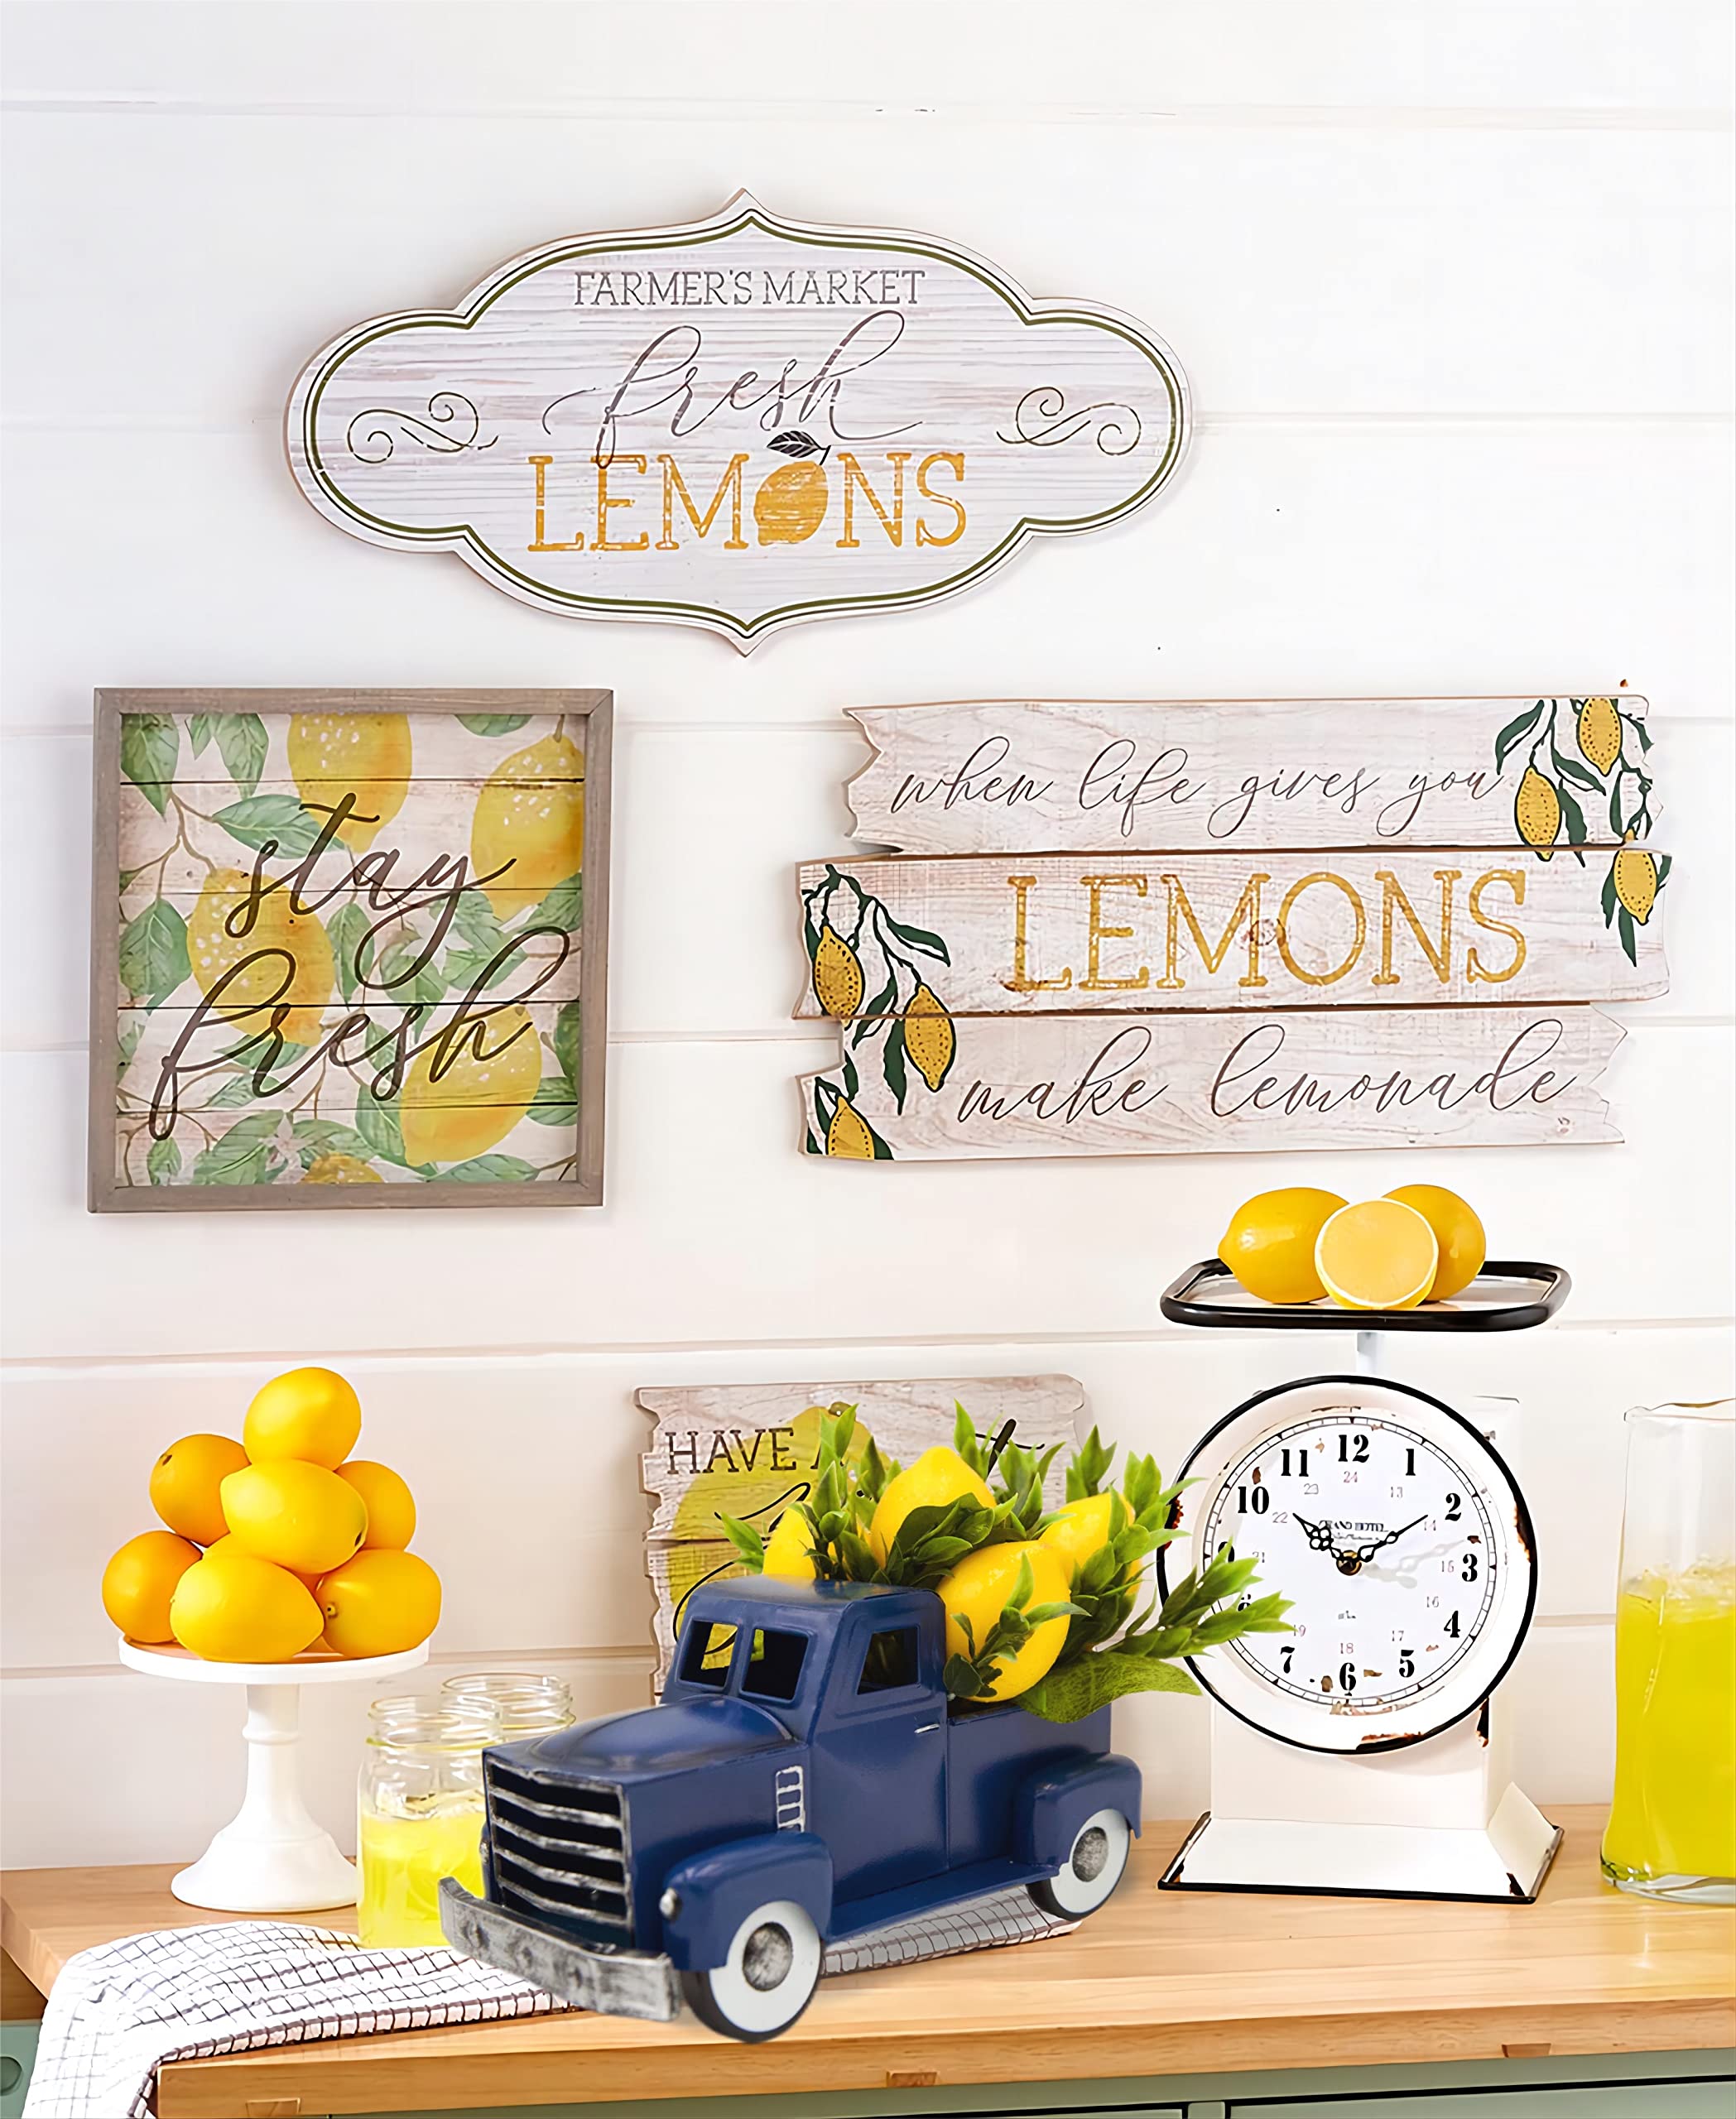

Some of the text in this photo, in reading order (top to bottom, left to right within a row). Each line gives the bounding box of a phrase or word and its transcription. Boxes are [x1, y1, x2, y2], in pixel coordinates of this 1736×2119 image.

[575, 270, 926, 306] FARMER'S MARKET
[543, 310, 927, 468] fresh
[892, 736, 1504, 838] when life gives you
[224, 792, 517, 989] stay
[1003, 867, 1530, 993] LEMONS
[148, 927, 570, 1140] fresh
[957, 1019, 1580, 1122] make lemonade
[665, 1426, 797, 1475] HAVE
[1281, 1449, 1310, 1478] 11
[1338, 1434, 1370, 1463] 12
[1405, 1448, 1416, 1477] 1
[1343, 1470, 1359, 1484] 24
[1237, 1486, 1270, 1515] 10
[1445, 1492, 1462, 1522] 2
[1461, 1553, 1479, 1583] 3
[1392, 1630, 1405, 1642] 17
[1443, 1610, 1461, 1638] 4
[1280, 1646, 1296, 1674] 7
[1339, 1642, 1354, 1655] 18
[1339, 1662, 1357, 1694] 6
[1398, 1649, 1416, 1679] 5
